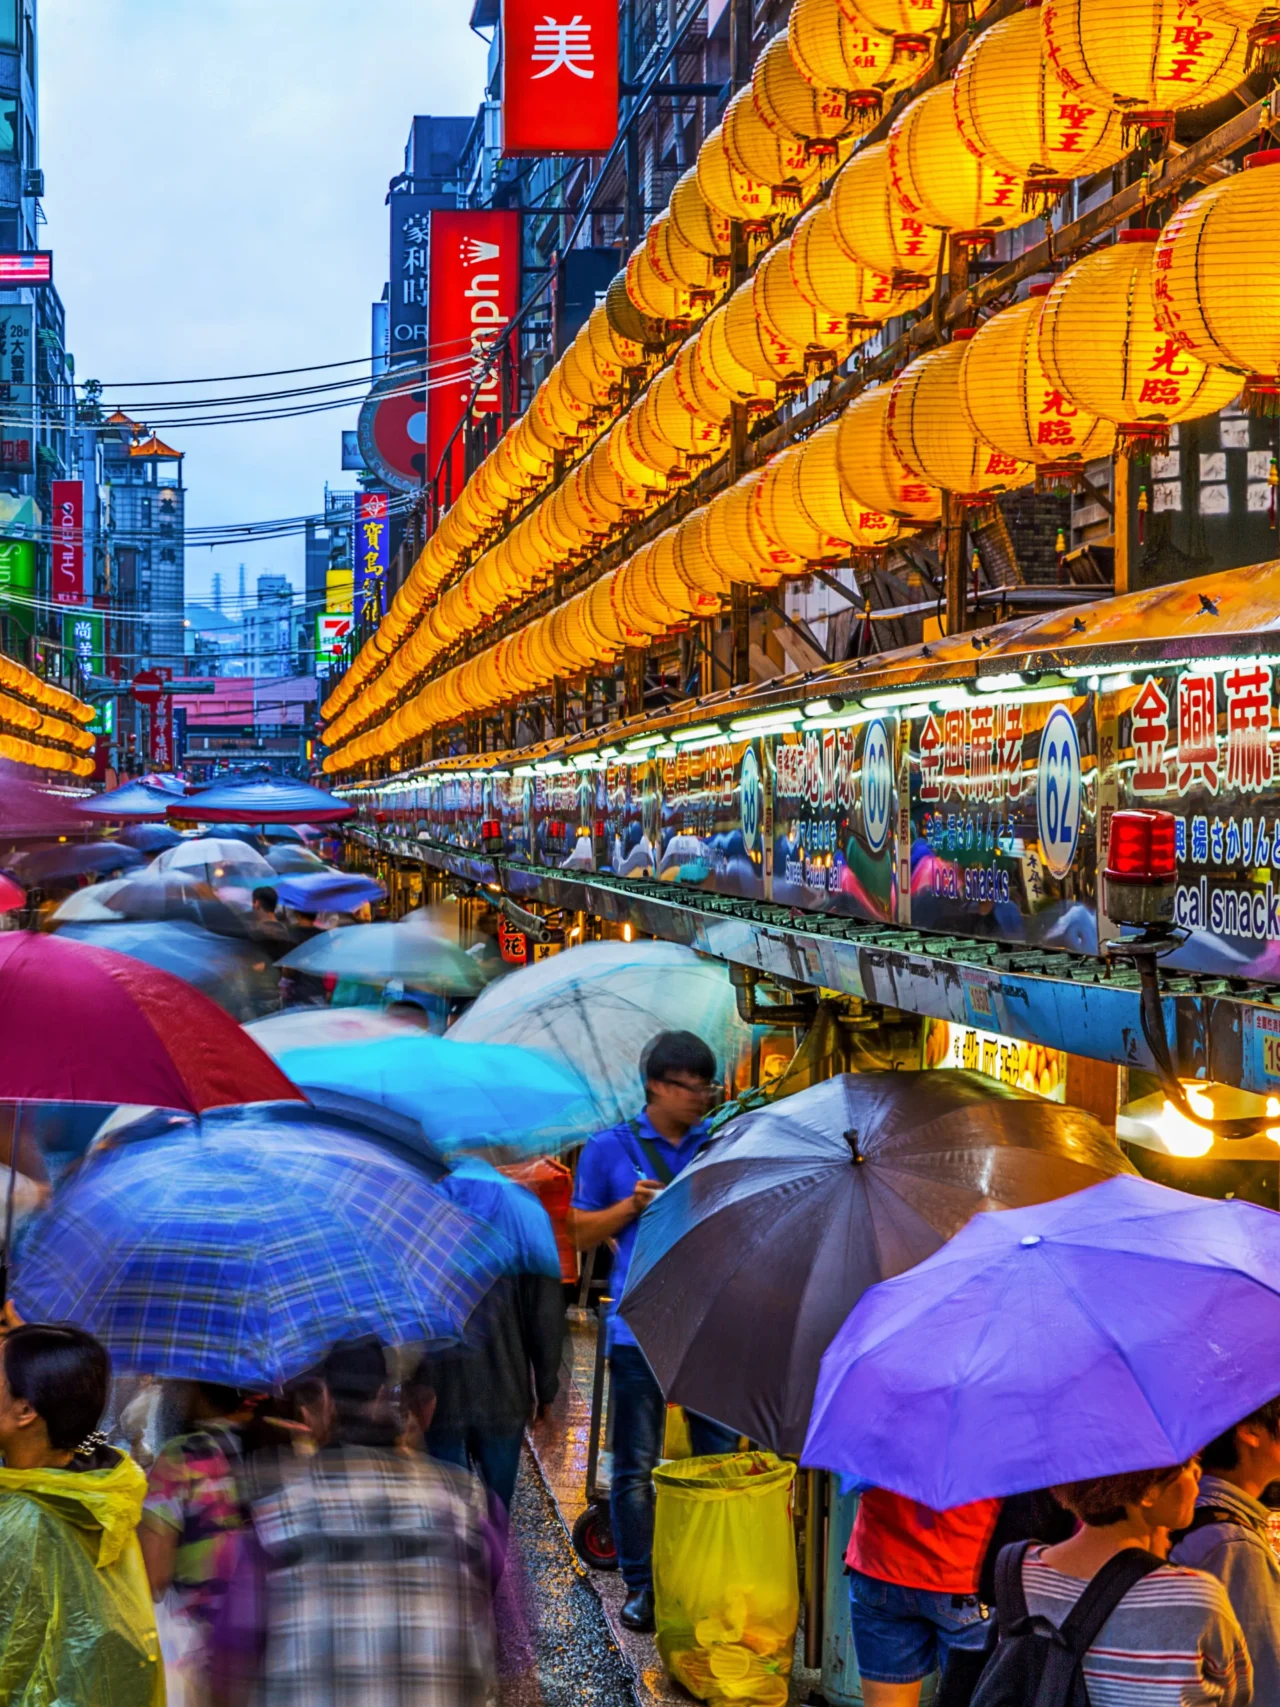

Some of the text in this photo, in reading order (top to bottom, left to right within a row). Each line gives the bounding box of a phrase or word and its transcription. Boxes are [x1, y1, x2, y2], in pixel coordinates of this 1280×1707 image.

[530, 15, 595, 80] 美
[402, 213, 428, 308] 豪利時
[1138, 339, 1189, 406] 光臨
[1038, 388, 1078, 446] 光臨
[868, 742, 886, 825] 60
[1048, 741, 1072, 845] 62
[931, 857, 1010, 904] local snacks
